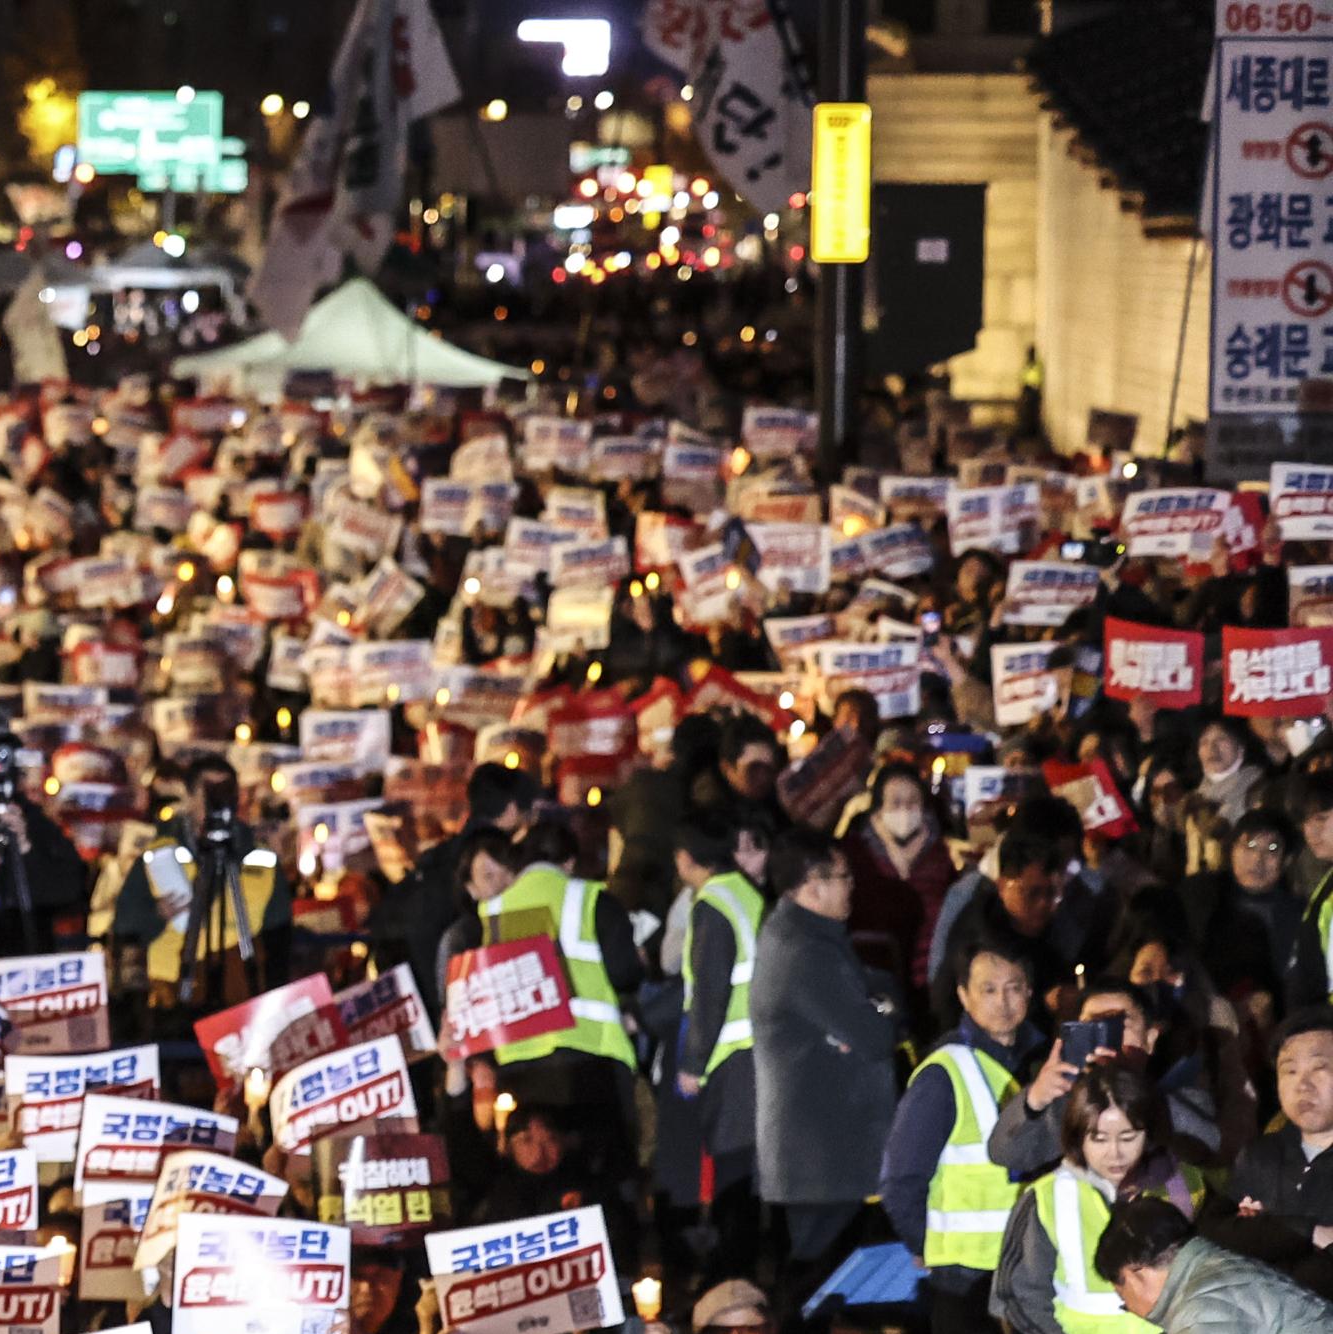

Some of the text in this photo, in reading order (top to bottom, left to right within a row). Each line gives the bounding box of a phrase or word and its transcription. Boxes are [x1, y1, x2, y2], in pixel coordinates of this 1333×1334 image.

[1228, 193, 1313, 250] 광화문
[27, 1056, 139, 1096] 국정농단
[103, 1112, 219, 1147] 국정농단
[452, 1217, 579, 1275] 국정농단
[528, 1250, 603, 1299] OUT!
